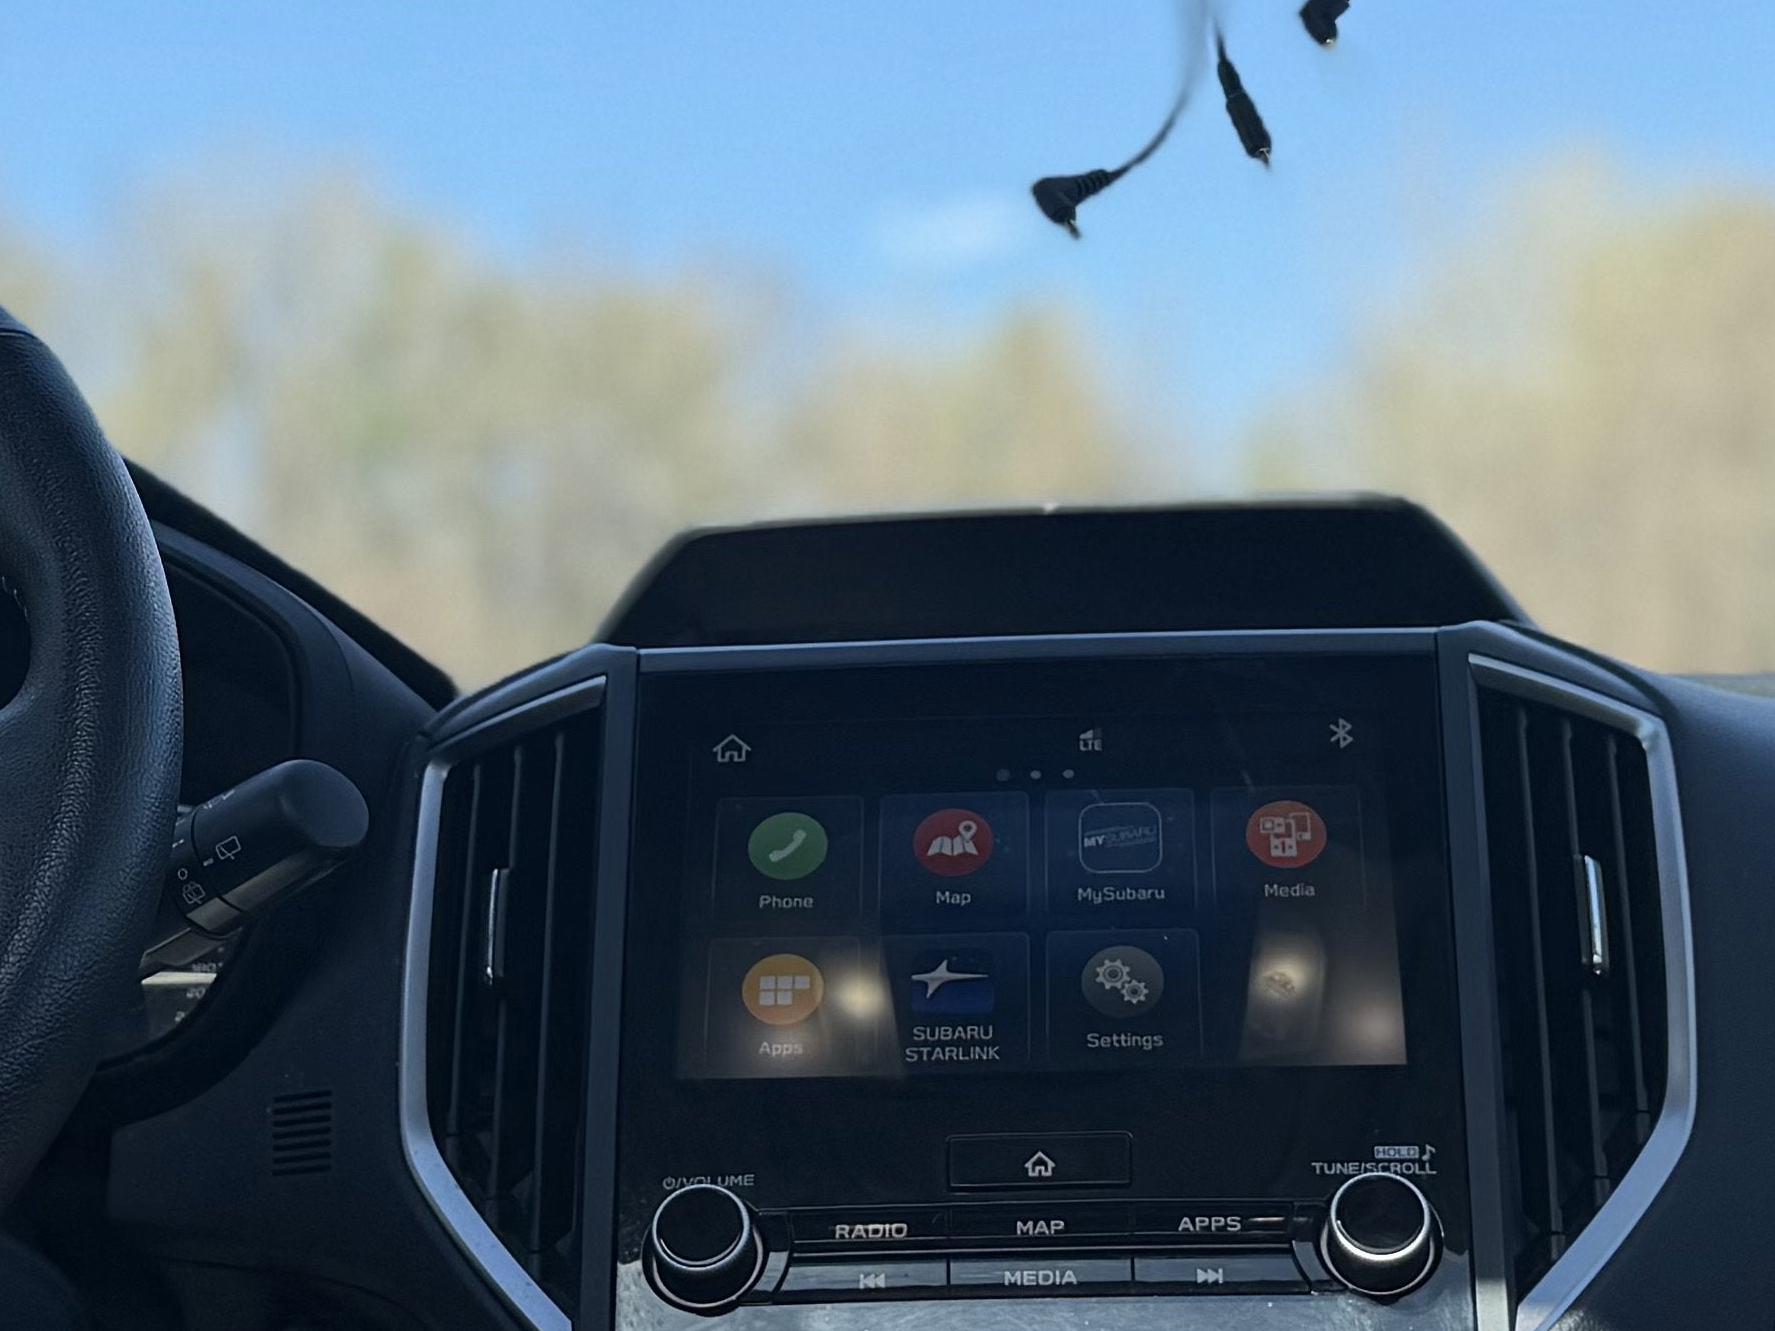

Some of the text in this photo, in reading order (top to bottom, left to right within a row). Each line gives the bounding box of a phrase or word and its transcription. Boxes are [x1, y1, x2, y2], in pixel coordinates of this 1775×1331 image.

[935, 890, 972, 907] Map
[1077, 886, 1165, 905] MySubaru
[1264, 882, 1316, 898] Media
[758, 894, 814, 909] Phone
[912, 1024, 994, 1041] SUBARU
[1086, 1032, 1164, 1049] Settings
[758, 1040, 804, 1057] Apps
[904, 1045, 1001, 1062] STARLINK
[1311, 1161, 1437, 1175] TUNE/SCROLL
[834, 1222, 908, 1239] RADIO
[1016, 1219, 1065, 1236] MAP
[1178, 1216, 1242, 1232] APPS
[1003, 1269, 1077, 1286] MEDIA
